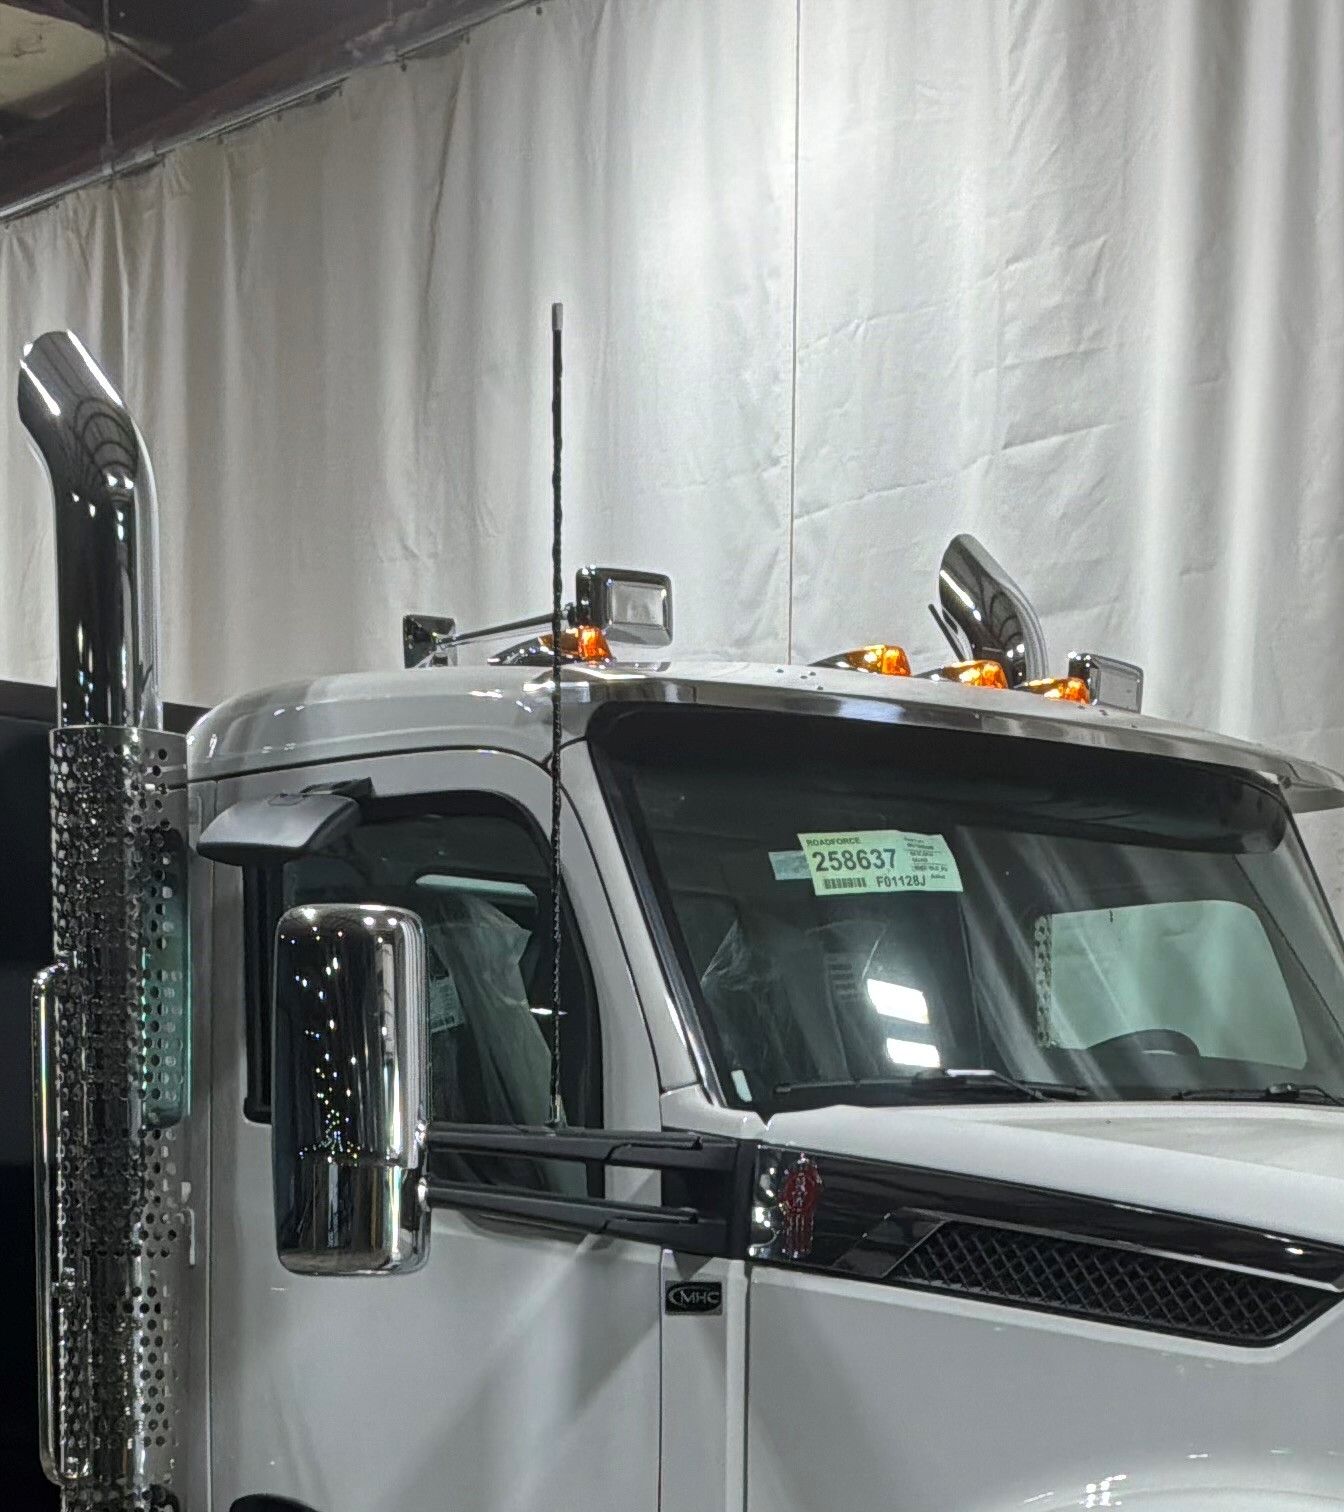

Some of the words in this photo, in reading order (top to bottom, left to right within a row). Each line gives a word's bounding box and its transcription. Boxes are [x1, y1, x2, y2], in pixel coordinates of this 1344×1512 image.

[805, 837, 861, 847] ROADFORCE
[812, 848, 896, 873] 258637
[876, 874, 926, 888] F01128J
